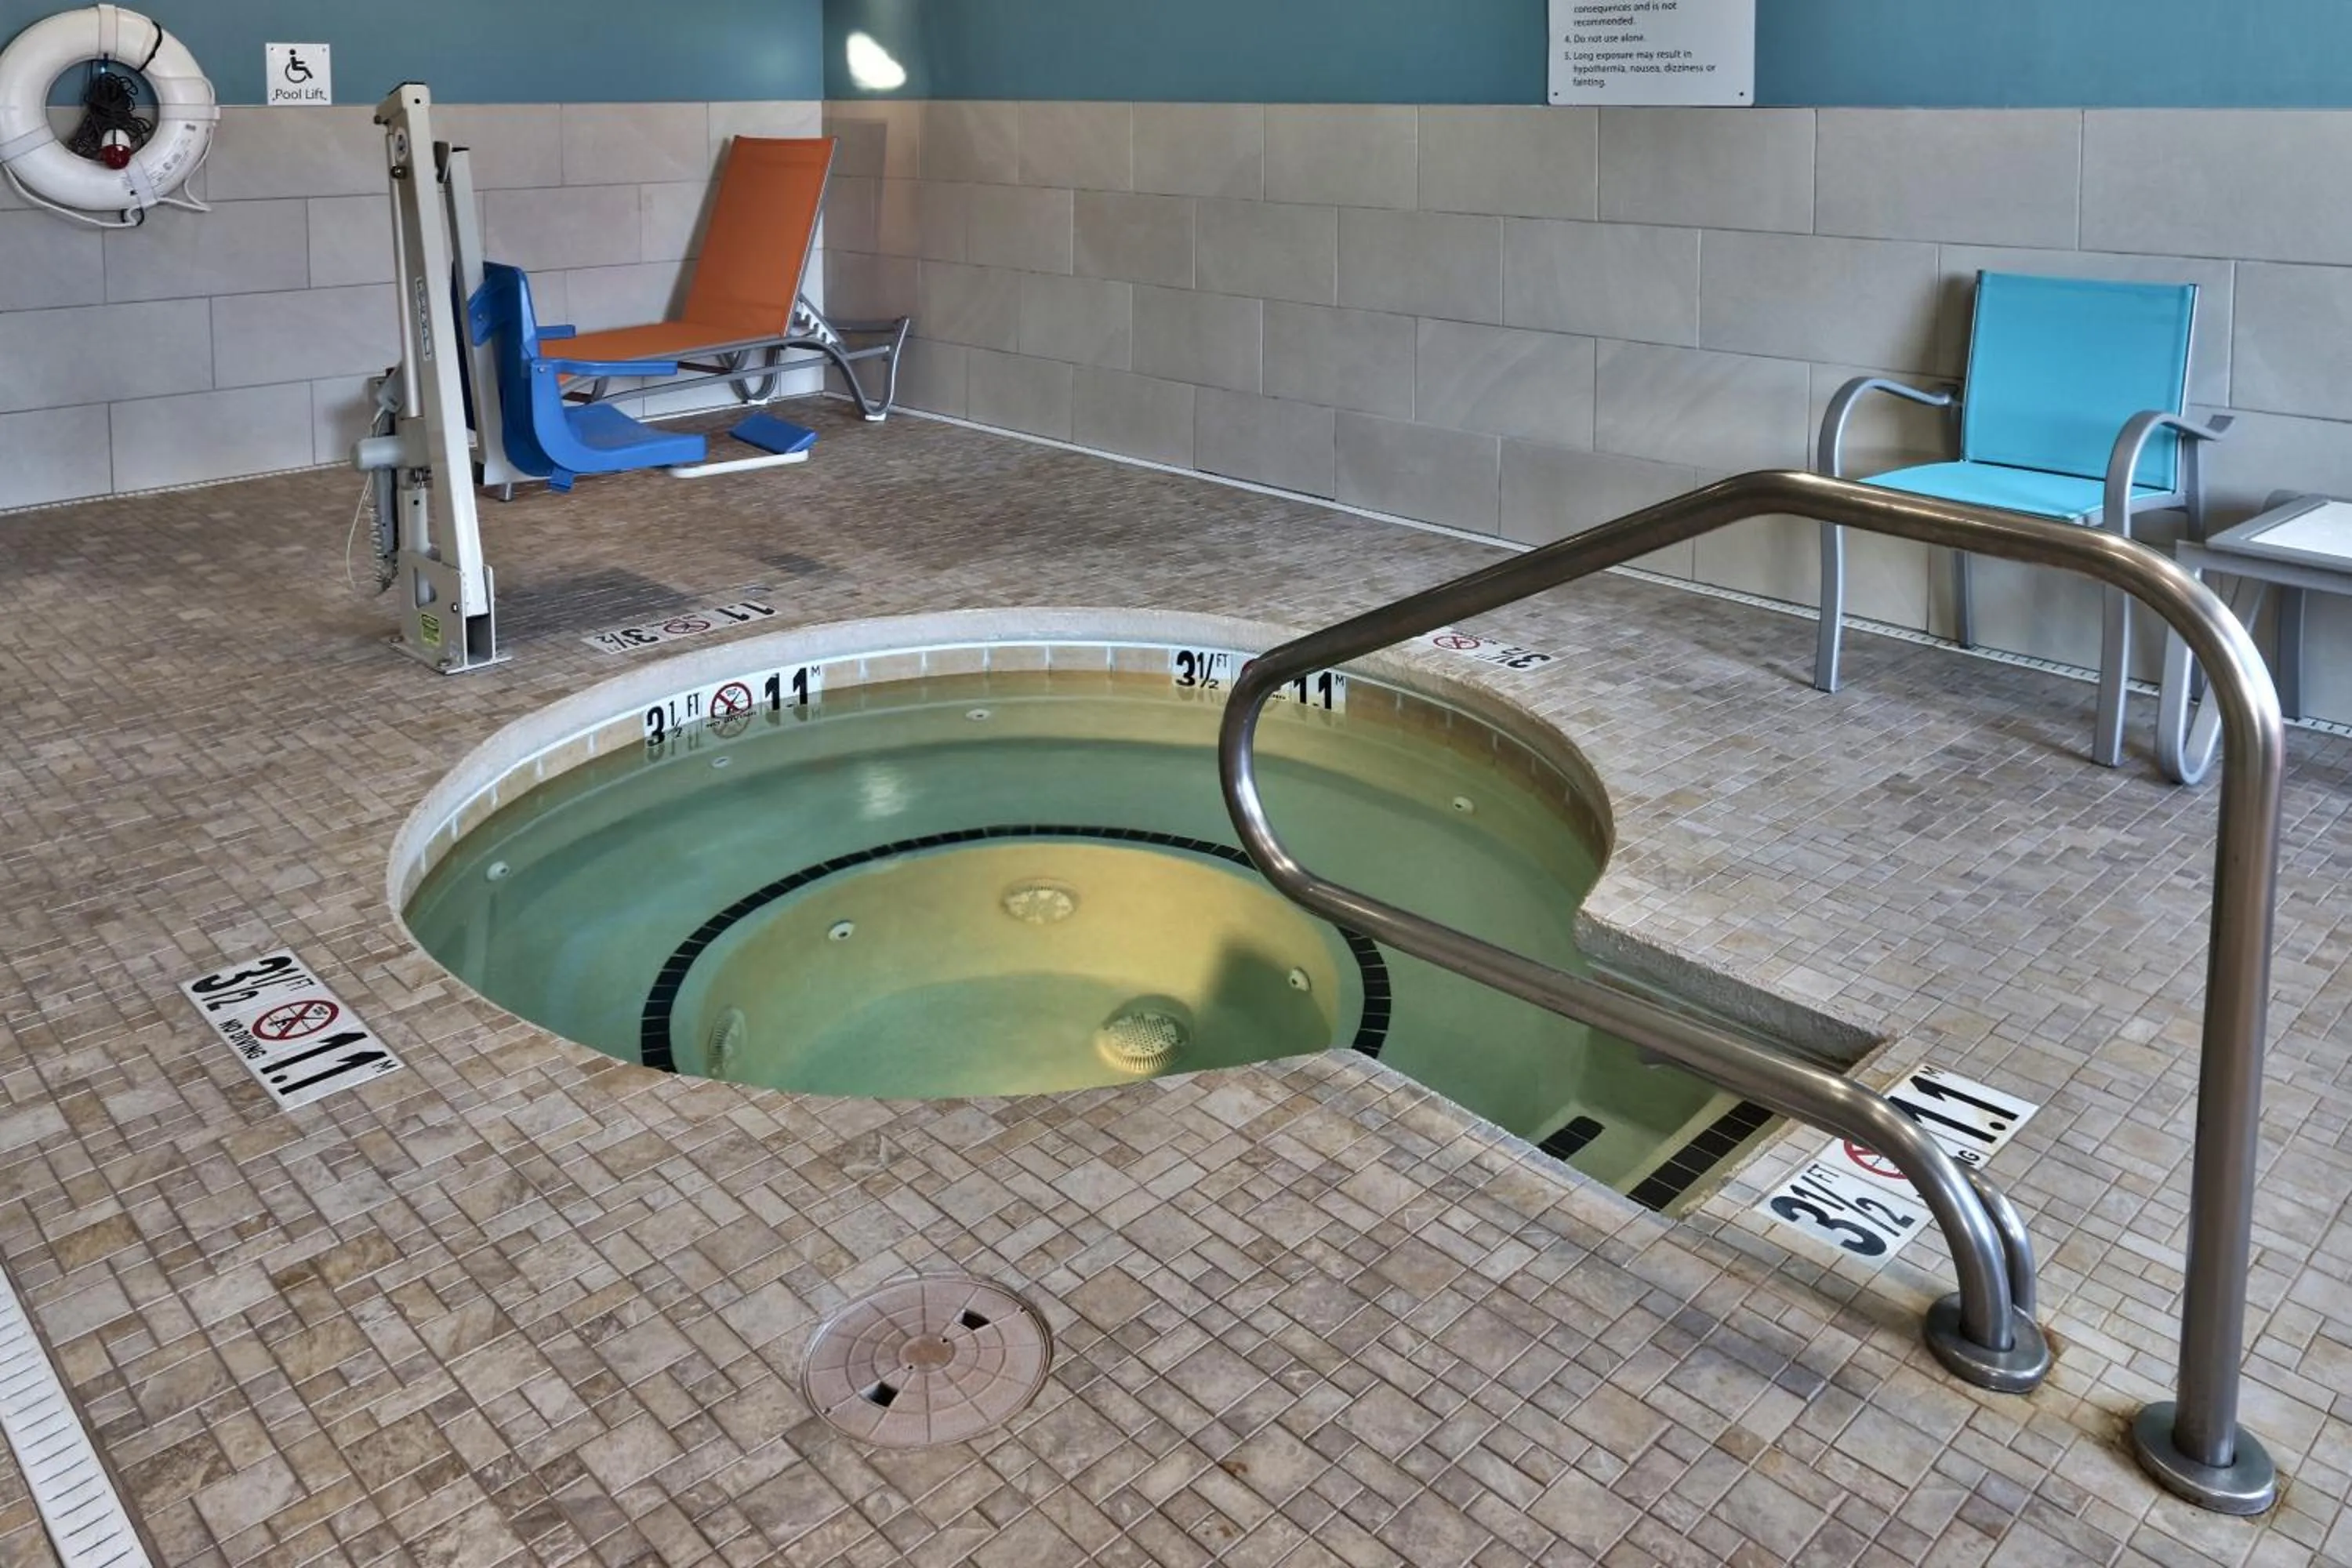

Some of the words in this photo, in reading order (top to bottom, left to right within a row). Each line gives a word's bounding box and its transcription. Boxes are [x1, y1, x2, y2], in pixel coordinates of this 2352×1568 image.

[1573, 4, 1632, 14] consequences
[1634, 3, 1650, 12] and
[1573, 34, 1585, 43] Do
[1573, 52, 1594, 61] Long
[1596, 52, 1633, 61] exposure
[1636, 51, 1654, 60] may
[1656, 49, 1682, 58] result
[1683, 49, 1693, 58] in
[1664, 63, 1704, 72] dizziness
[275, 89, 302, 100] Pool
[305, 88, 325, 100] Lift
[1216, 653, 1228, 668] FT
[811, 665, 821, 677] M
[1335, 675, 1345, 688] M
[687, 692, 700, 717] FT
[285, 978, 315, 992] FT
[218, 1018, 245, 1034] NO
[228, 1029, 267, 1060] DIVING
[371, 1059, 399, 1073] M
[1920, 1065, 1945, 1080] M
[1806, 1163, 1841, 1184] FT
